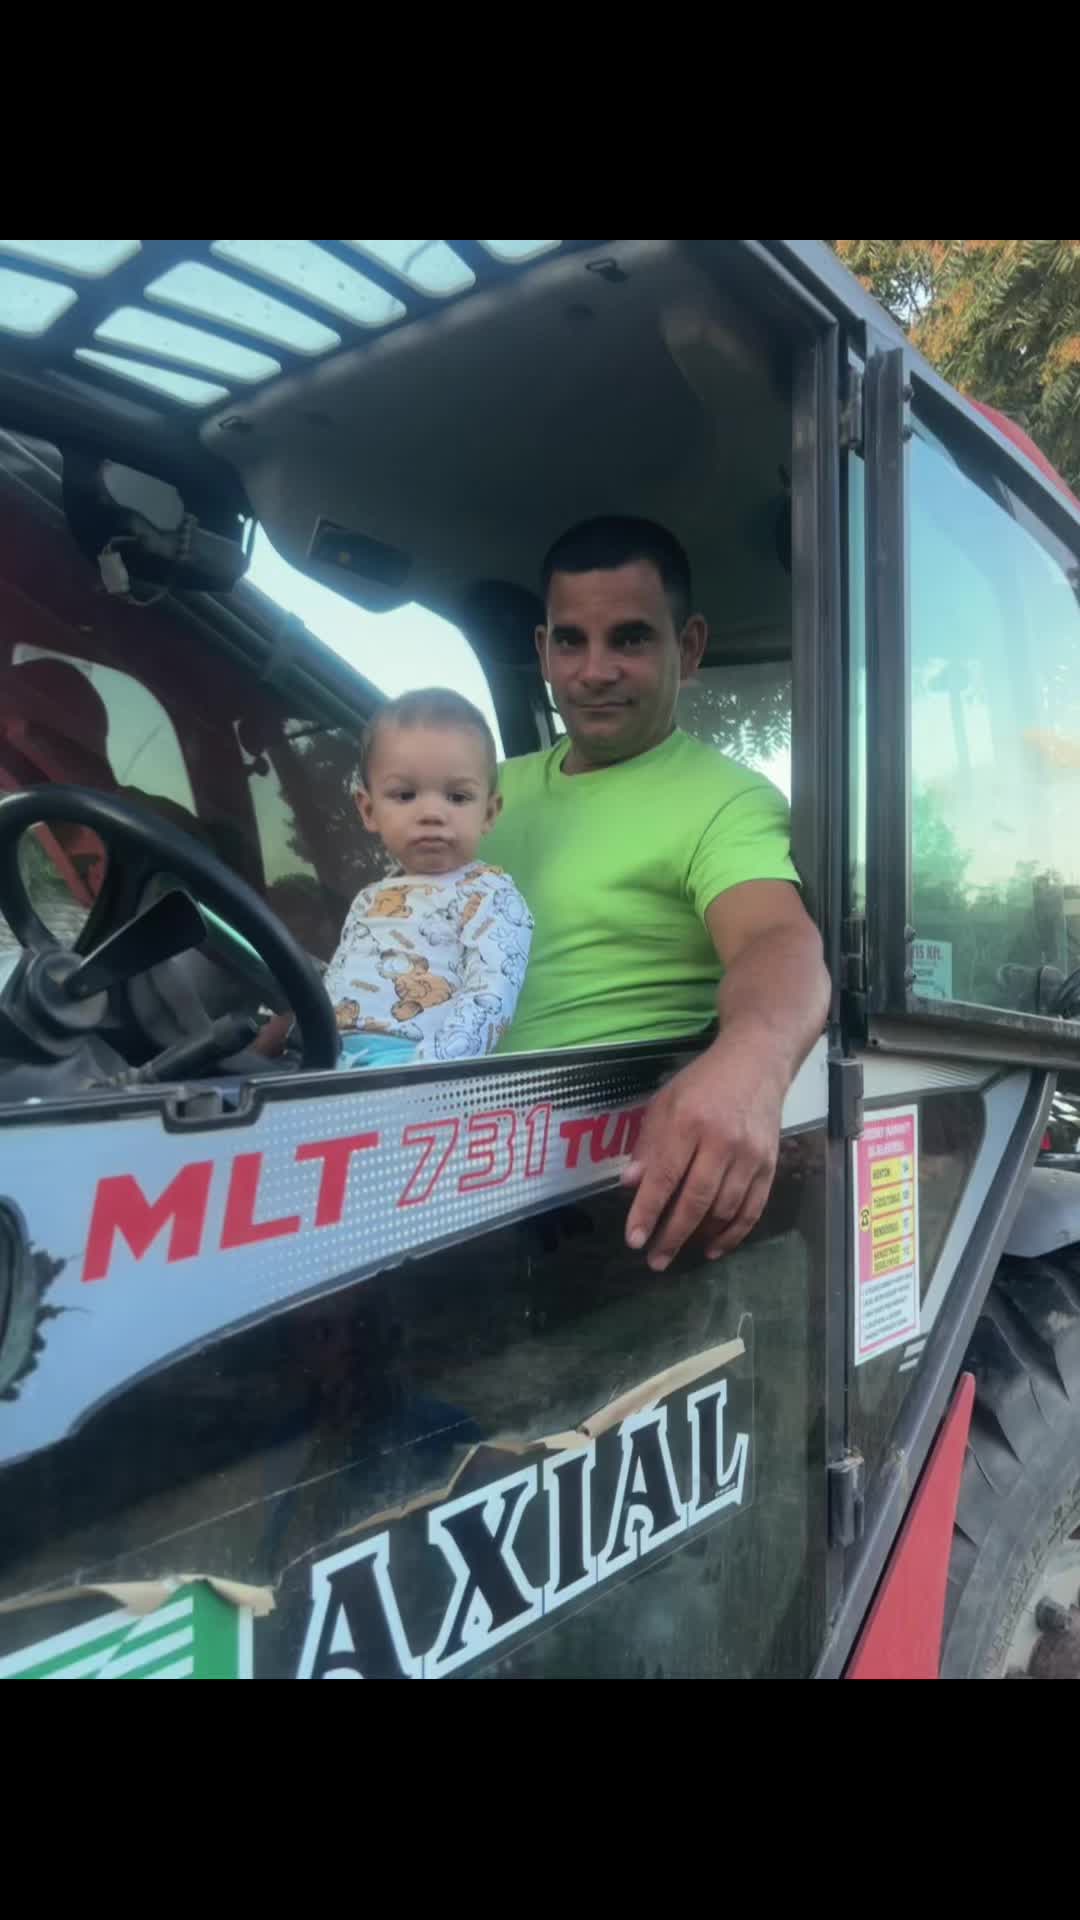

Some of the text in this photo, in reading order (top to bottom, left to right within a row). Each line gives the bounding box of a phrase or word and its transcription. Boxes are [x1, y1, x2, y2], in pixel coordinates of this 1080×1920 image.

[81, 1132, 379, 1283] MLT
[396, 1102, 553, 1208] 731
[297, 1379, 749, 1679] AXIAL
